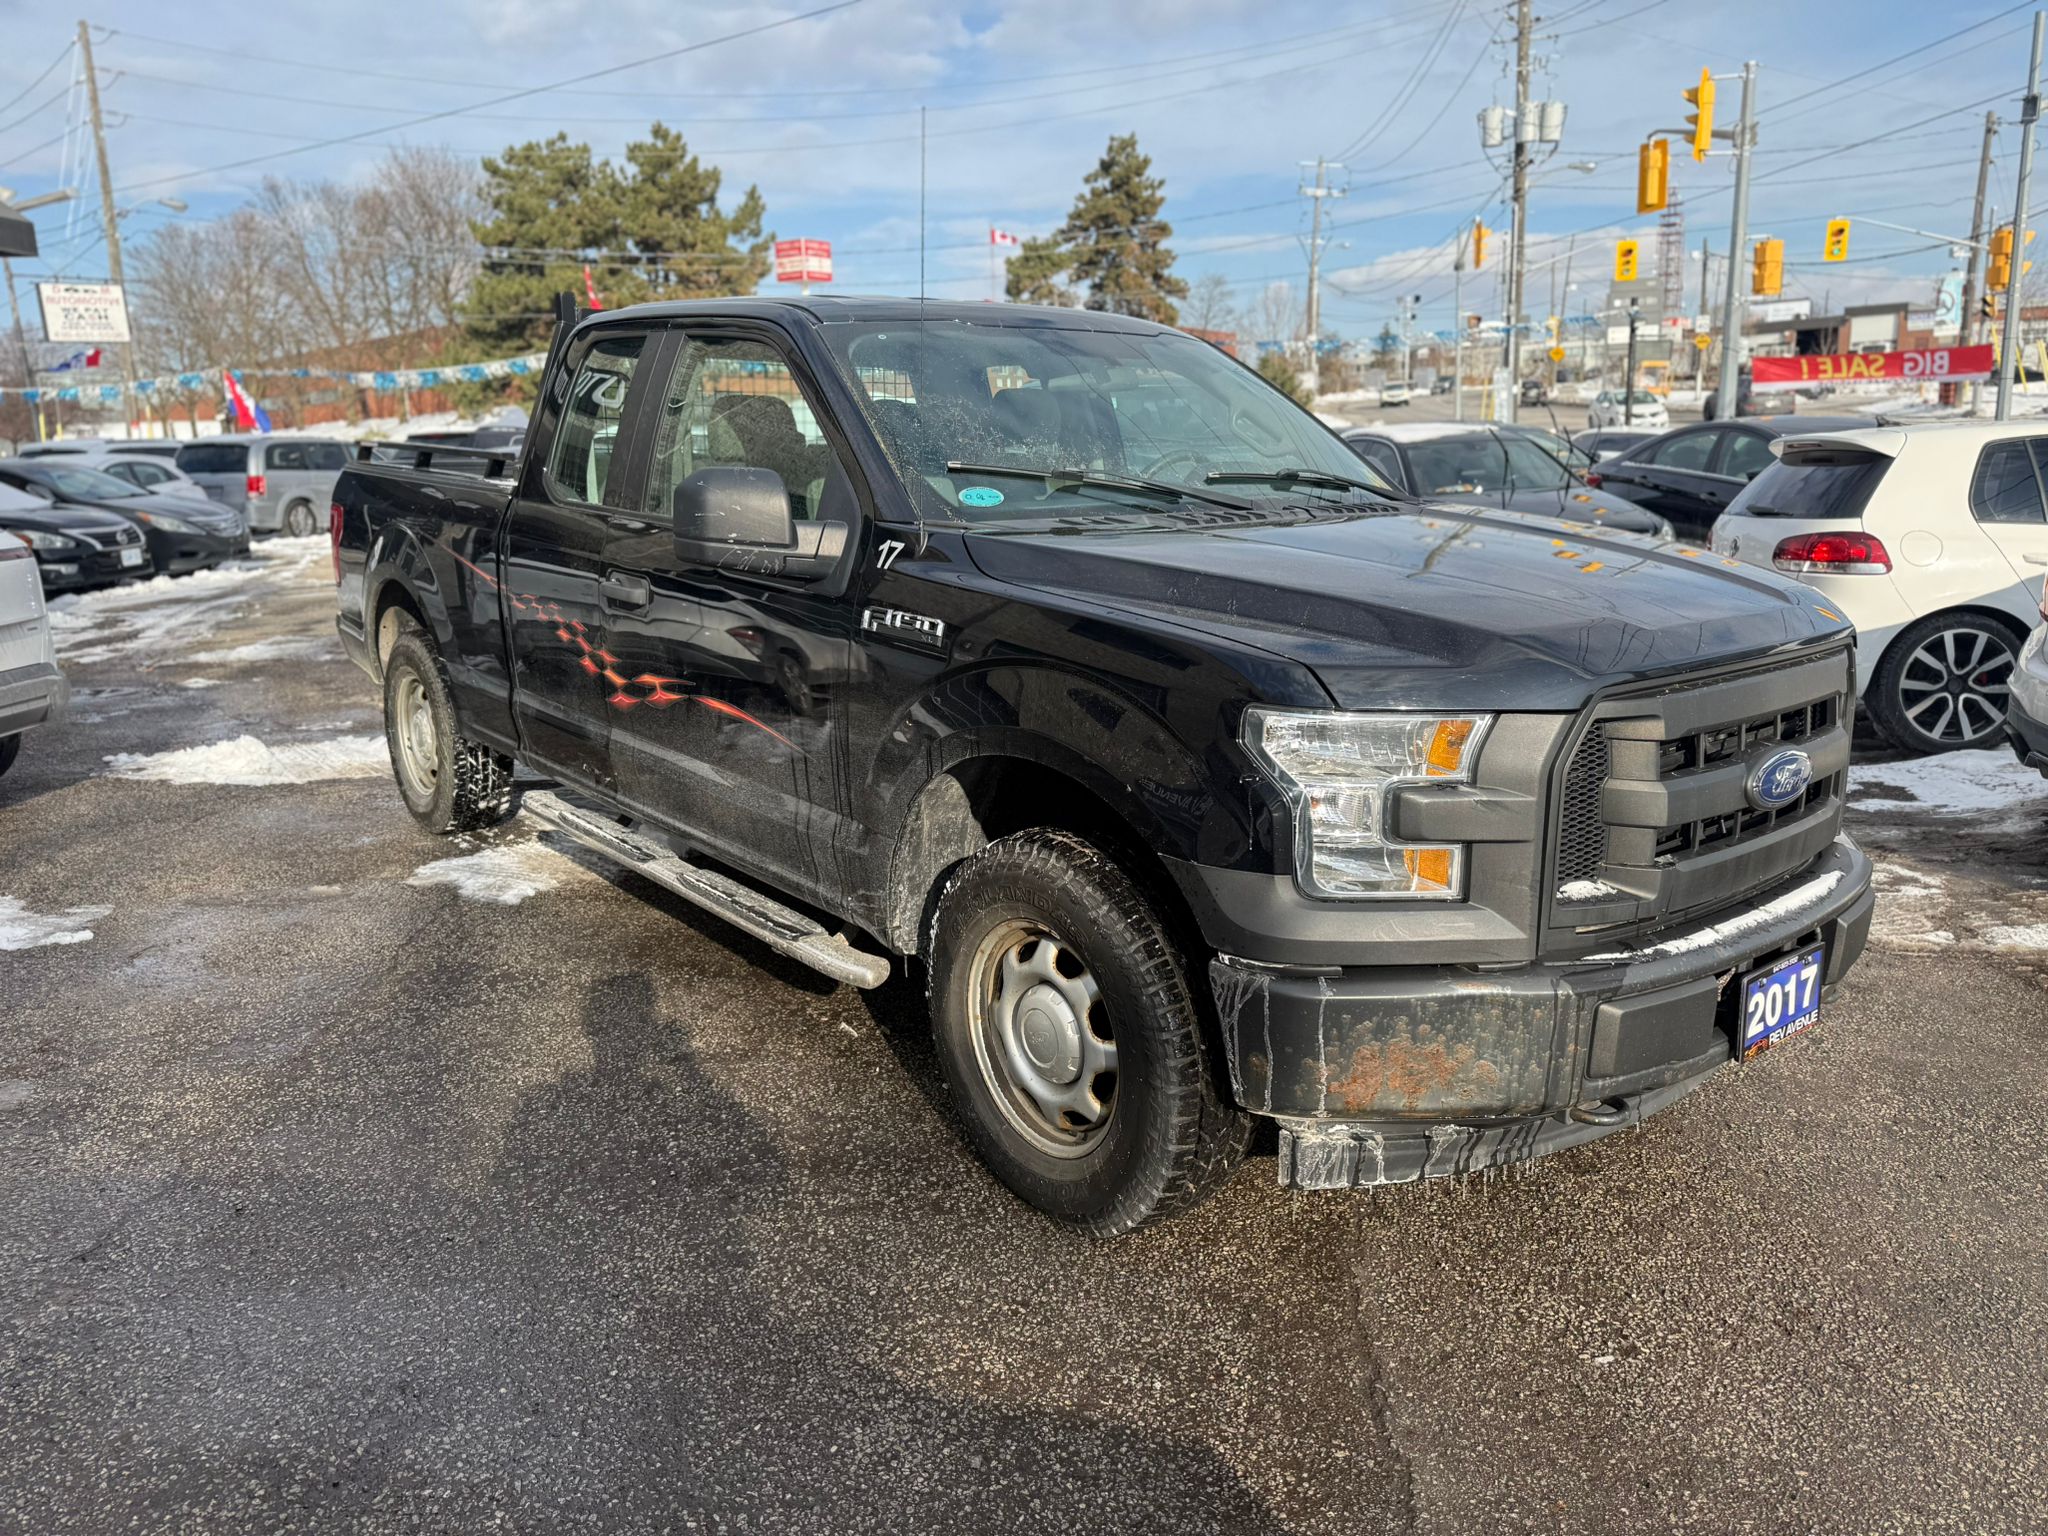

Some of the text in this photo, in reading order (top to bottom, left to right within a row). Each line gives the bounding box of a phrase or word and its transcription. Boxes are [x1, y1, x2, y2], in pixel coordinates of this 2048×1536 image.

[876, 539, 906, 570] 17
[1772, 762, 1806, 796] Ford
[1747, 964, 1818, 1039] 2017
[1768, 1009, 1819, 1046] REV AVENUE
